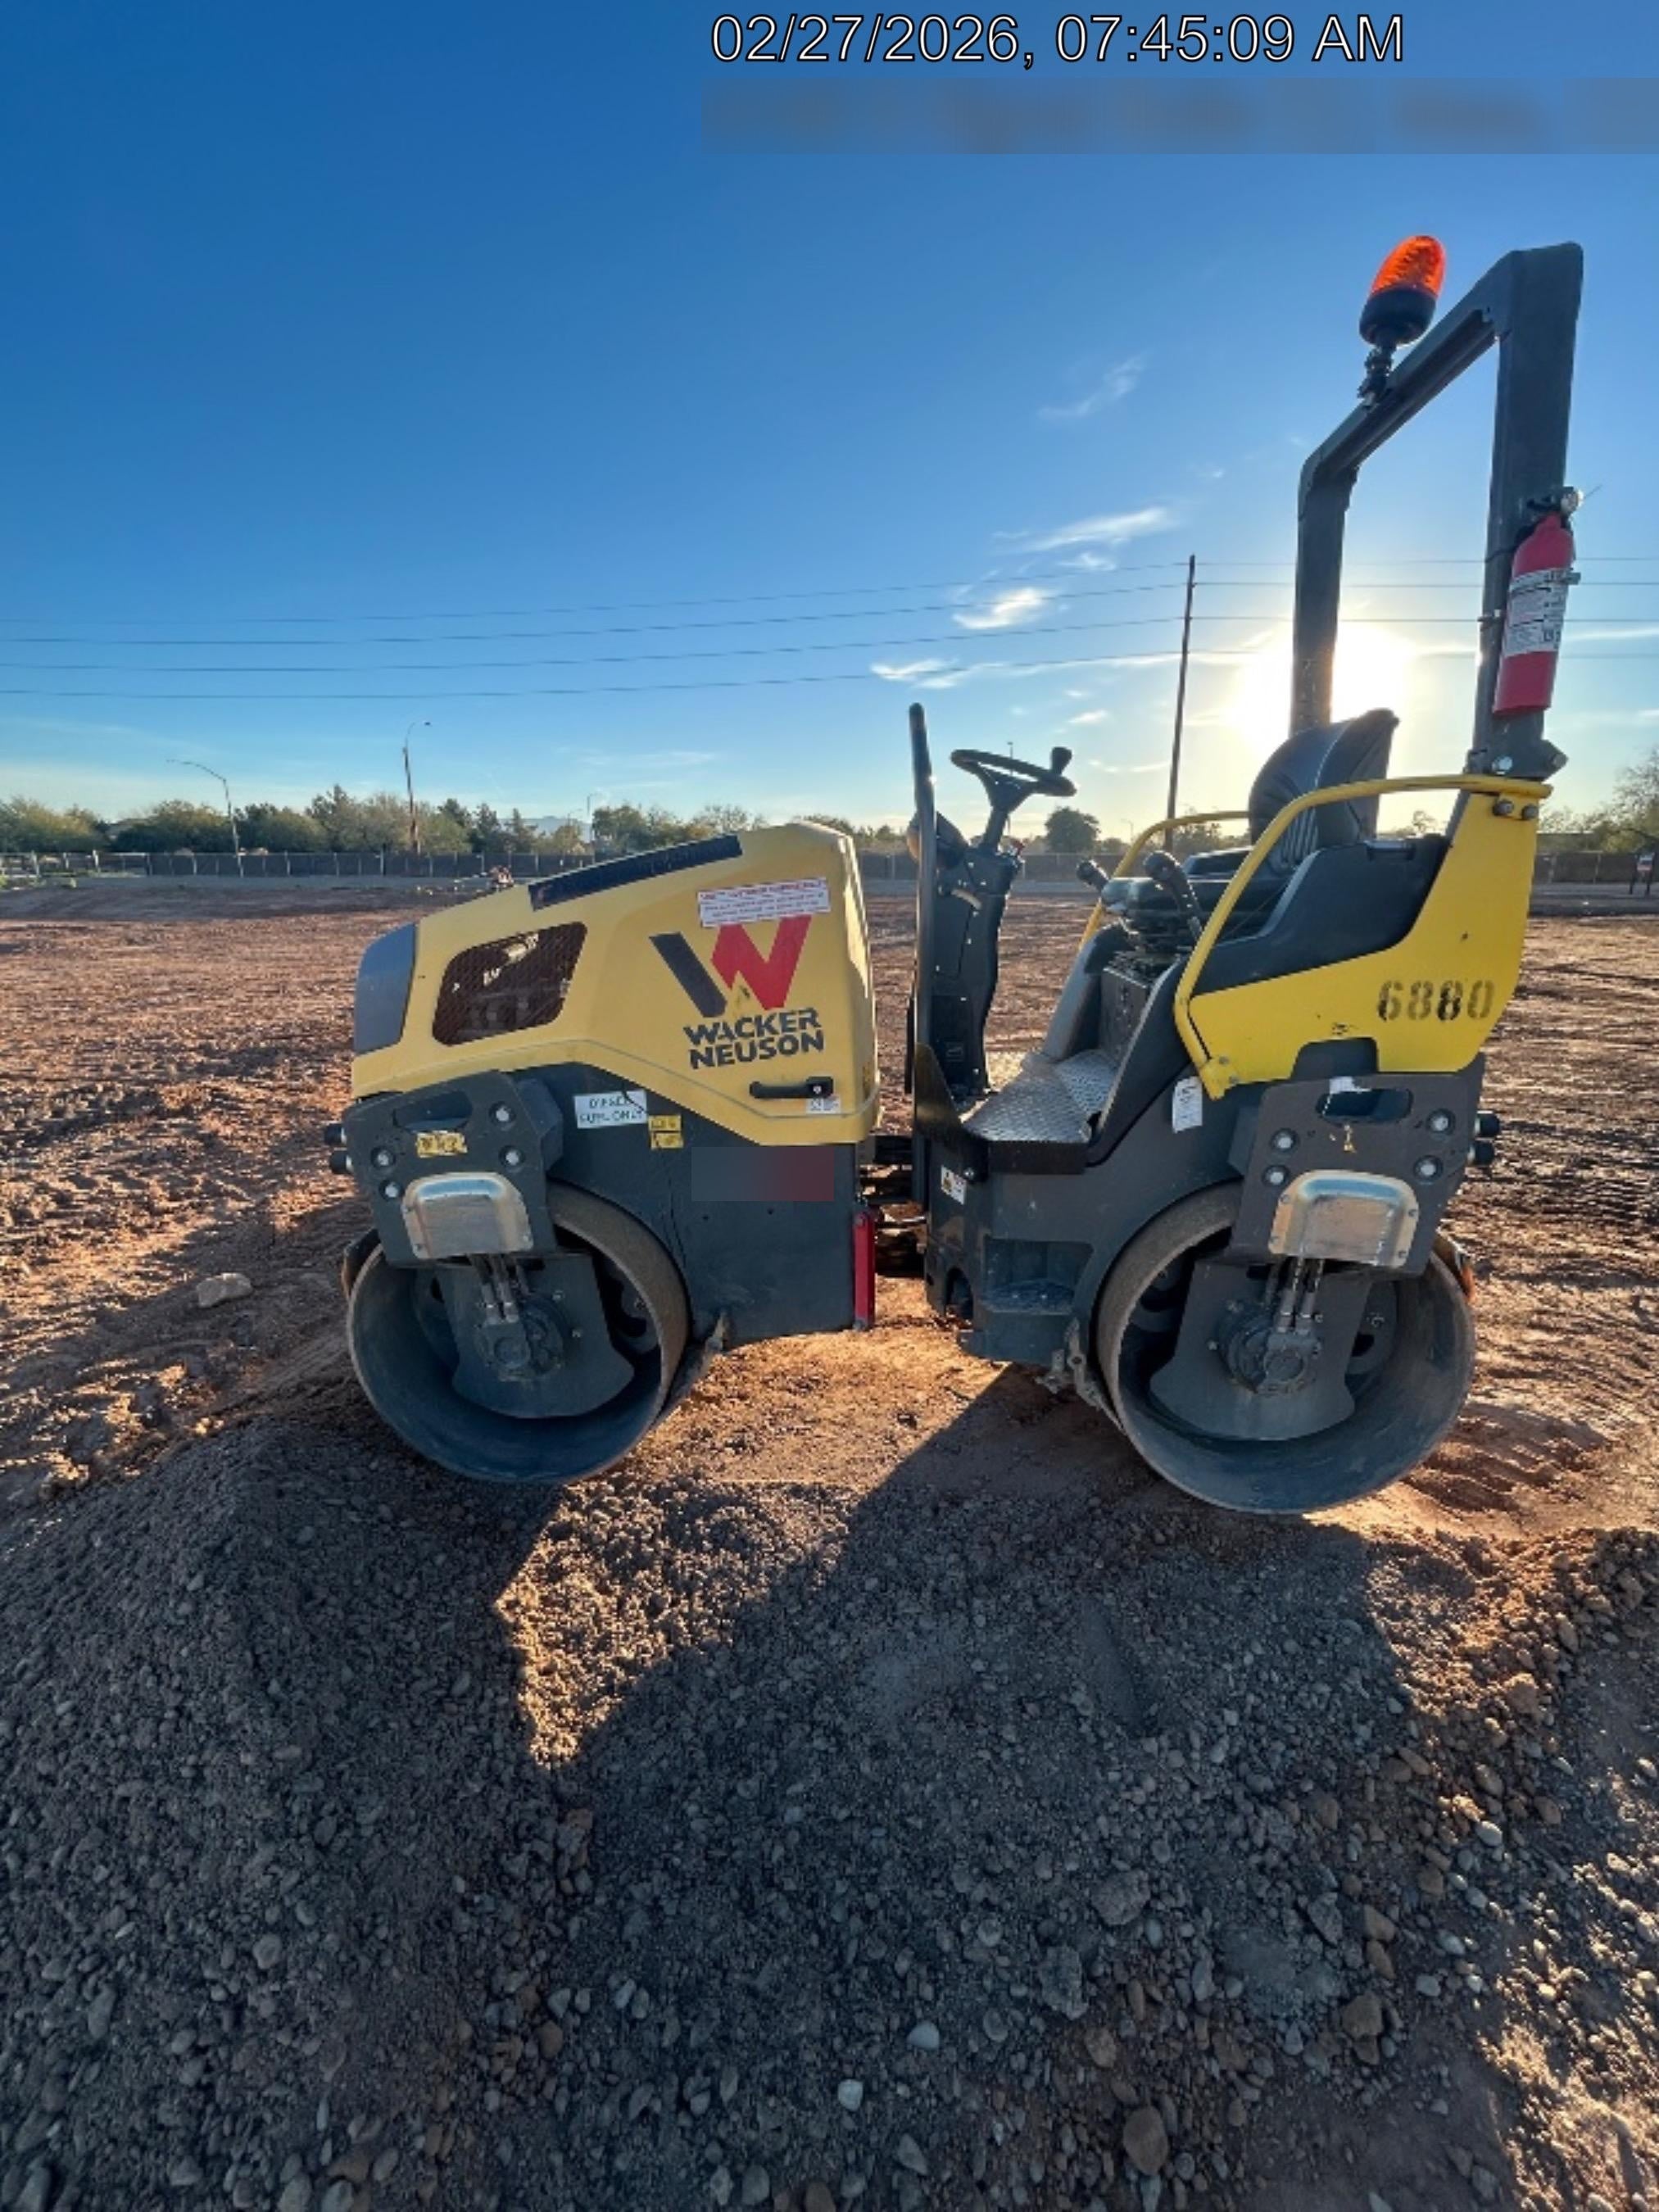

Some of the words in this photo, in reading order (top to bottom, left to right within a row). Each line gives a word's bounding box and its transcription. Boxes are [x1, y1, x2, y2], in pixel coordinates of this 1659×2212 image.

[1378, 981, 1494, 1021] 6880
[682, 1008, 822, 1045] WACKER
[689, 1030, 824, 1069] NEUSON
